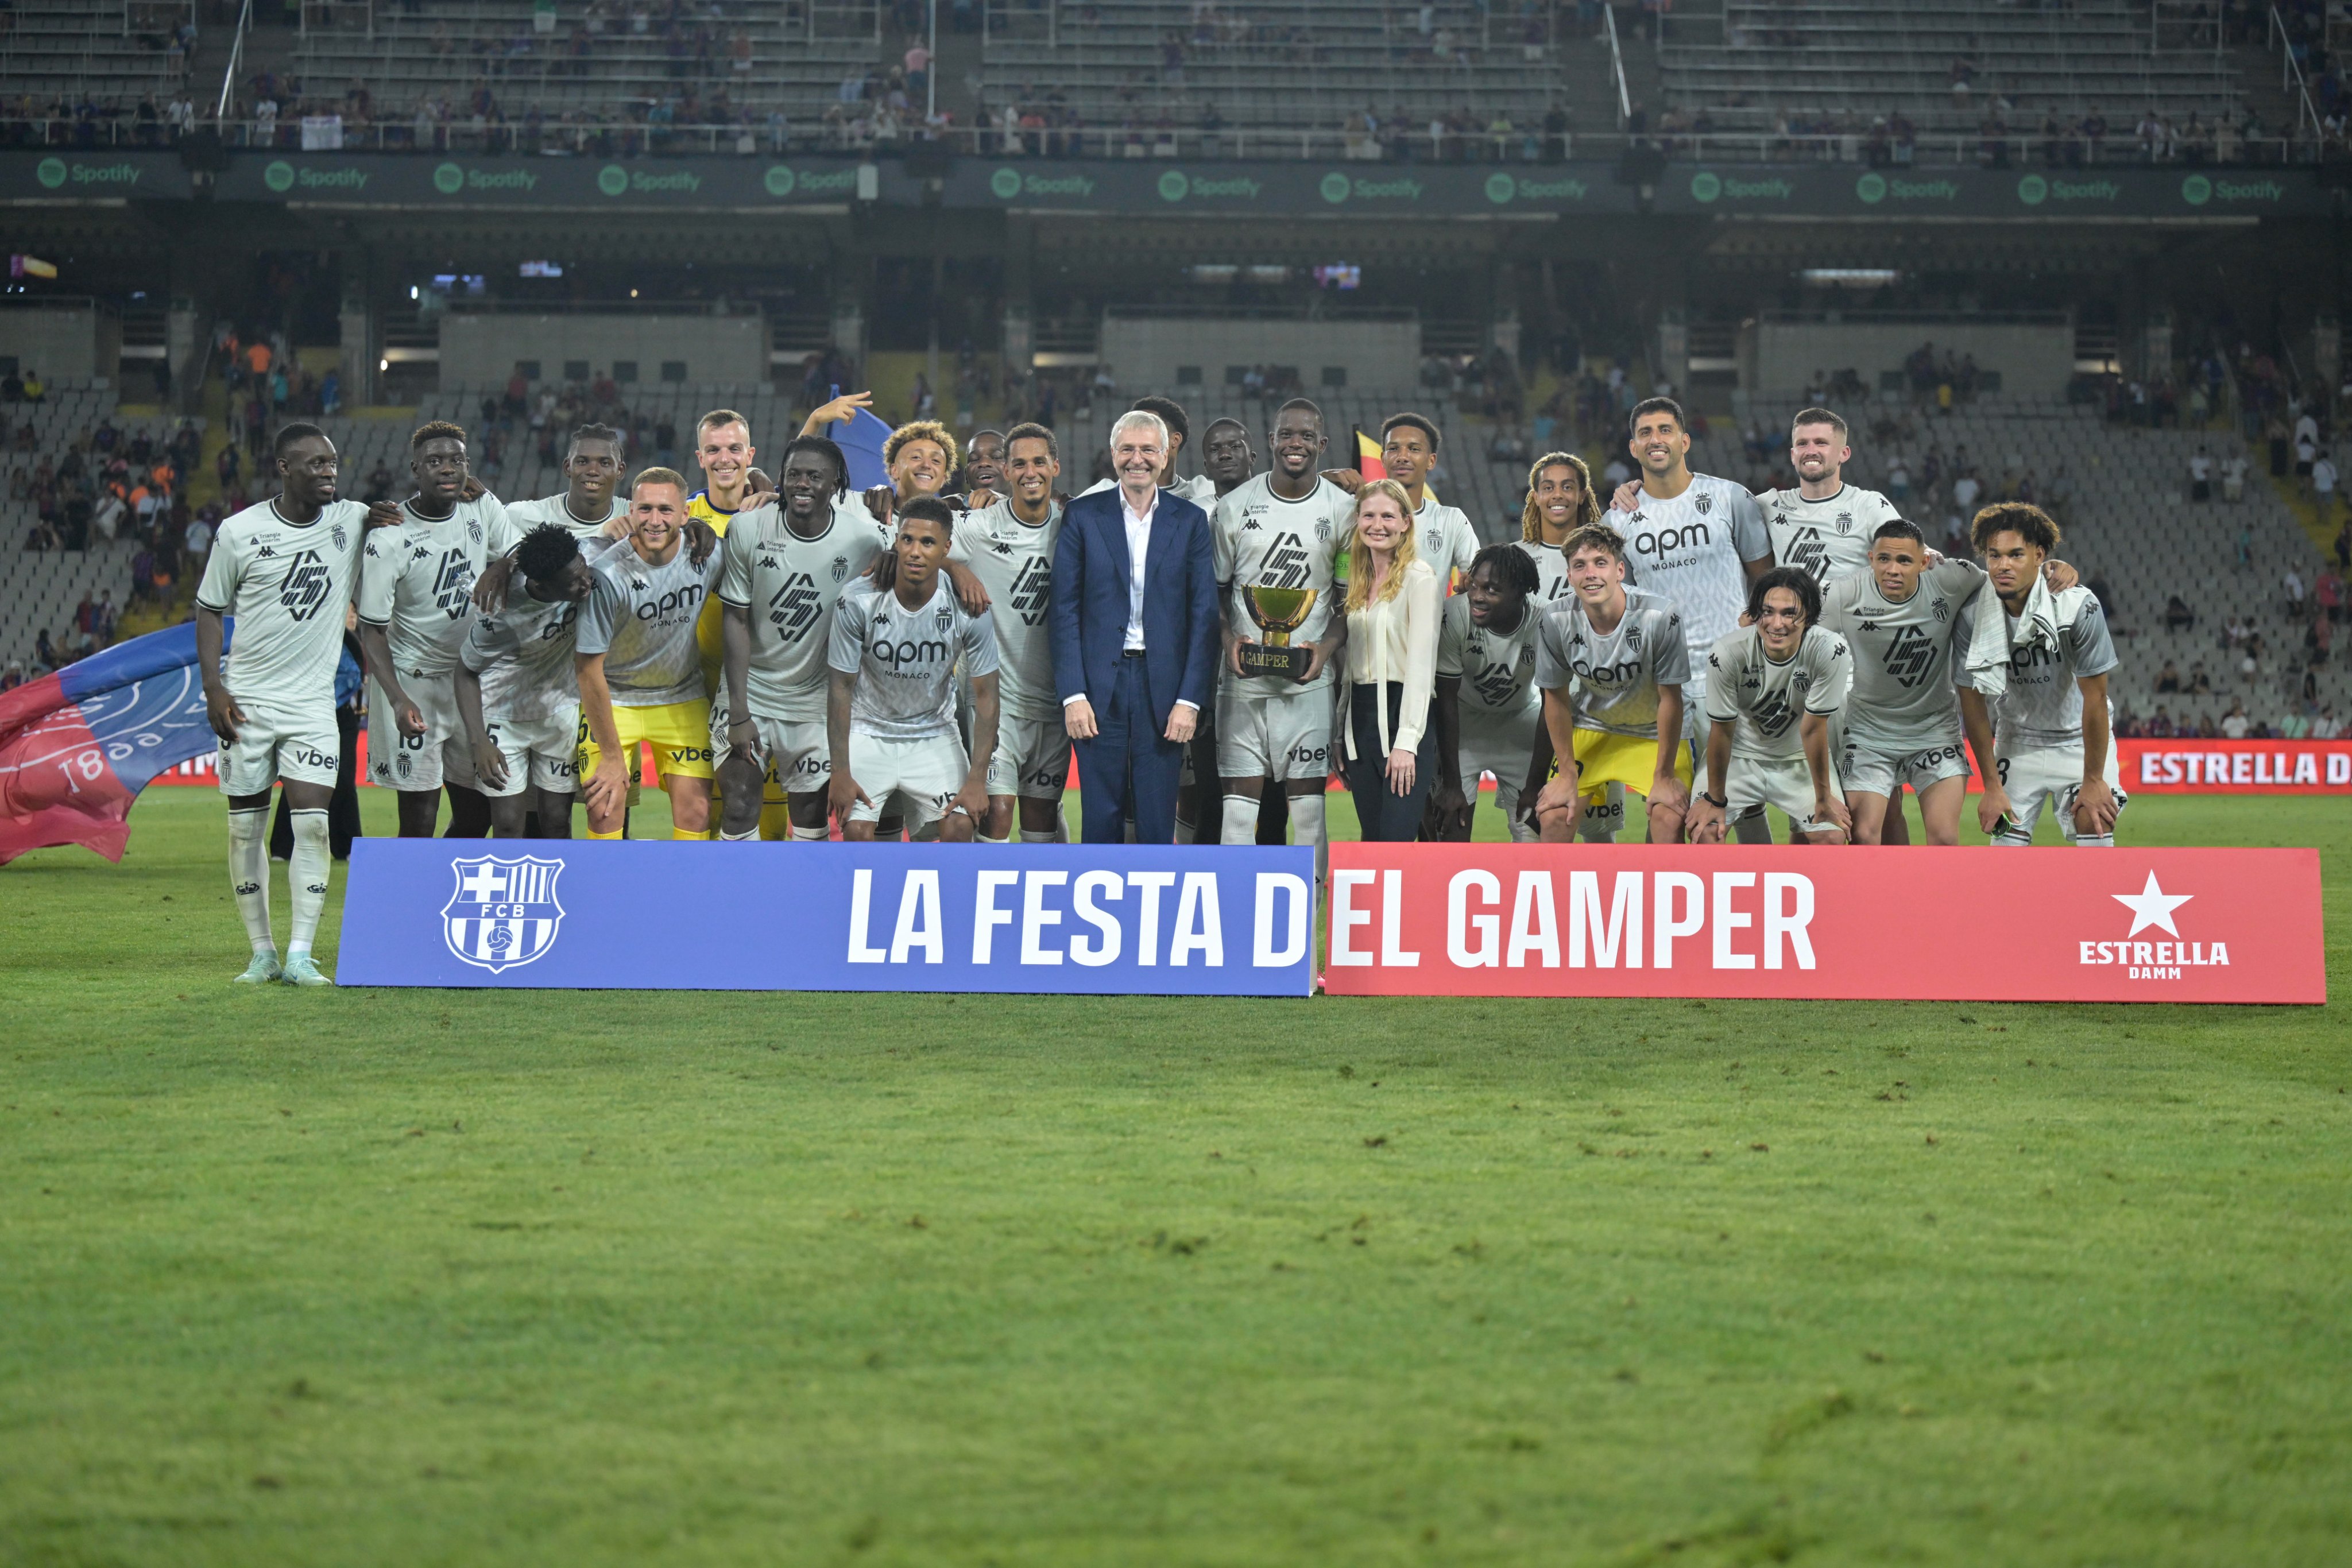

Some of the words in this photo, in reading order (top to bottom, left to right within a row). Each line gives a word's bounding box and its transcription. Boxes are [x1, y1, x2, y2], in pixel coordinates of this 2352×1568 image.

[72, 164, 140, 184] Spotify
[299, 168, 368, 188] Spotify
[468, 169, 536, 191] Spotify
[632, 172, 701, 192] Spotify
[799, 172, 857, 192] Spotif
[1026, 176, 1094, 196] Spotify
[1192, 177, 1260, 198] Spotify
[1354, 179, 1423, 199] Spotify
[1519, 179, 1587, 199] Spotify
[1724, 178, 1793, 199] Spotify
[1891, 179, 1958, 200] Spotify
[2052, 180, 2121, 200] Spotify
[2216, 180, 2283, 201] Spotify
[409, 529, 431, 539] Triangle
[1635, 523, 1710, 560] apm
[1651, 558, 1697, 571] MONACO
[637, 584, 703, 621] apm
[649, 615, 691, 630] MONACO
[872, 640, 946, 671] apm
[1245, 652, 1289, 668] GAMPER
[2006, 644, 2061, 676] pm
[885, 670, 930, 679] MONACO
[1572, 660, 1642, 685] apm
[296, 749, 338, 772] vbet
[671, 746, 713, 762] vbe
[1287, 743, 1330, 762] vbet
[1914, 745, 1963, 771] vbet
[550, 761, 579, 777] vbe
[795, 757, 831, 775] vbe
[2142, 752, 2318, 784] ESTRELLA
[848, 869, 943, 964] LA
[972, 869, 1224, 967] FESTA
[1446, 868, 1816, 970] GAMPER
[2079, 941, 2230, 965] ESTRELLA
[2129, 967, 2181, 979] DAMM
